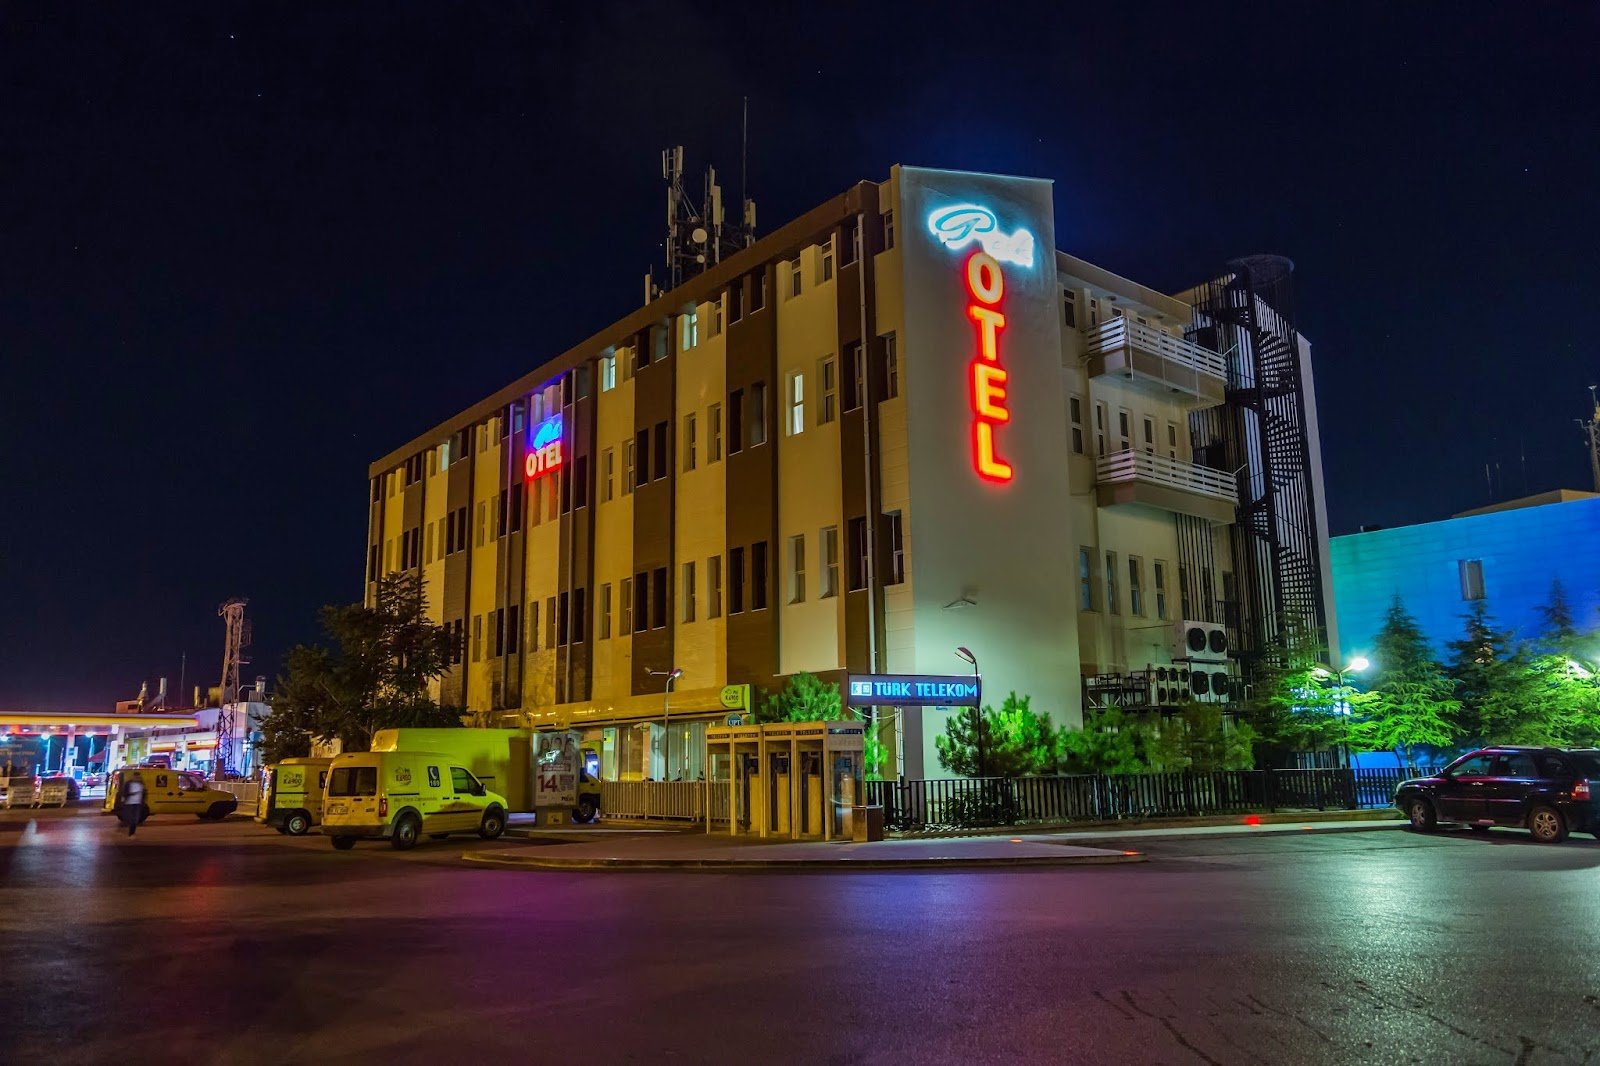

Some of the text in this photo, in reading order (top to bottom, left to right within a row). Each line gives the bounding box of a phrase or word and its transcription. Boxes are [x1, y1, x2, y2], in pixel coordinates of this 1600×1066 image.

[967, 251, 1012, 479] OTEL
[525, 440, 562, 477] OTEL
[874, 682, 977, 697] TÜRK TELEKOM
[537, 774, 558, 793] 14
